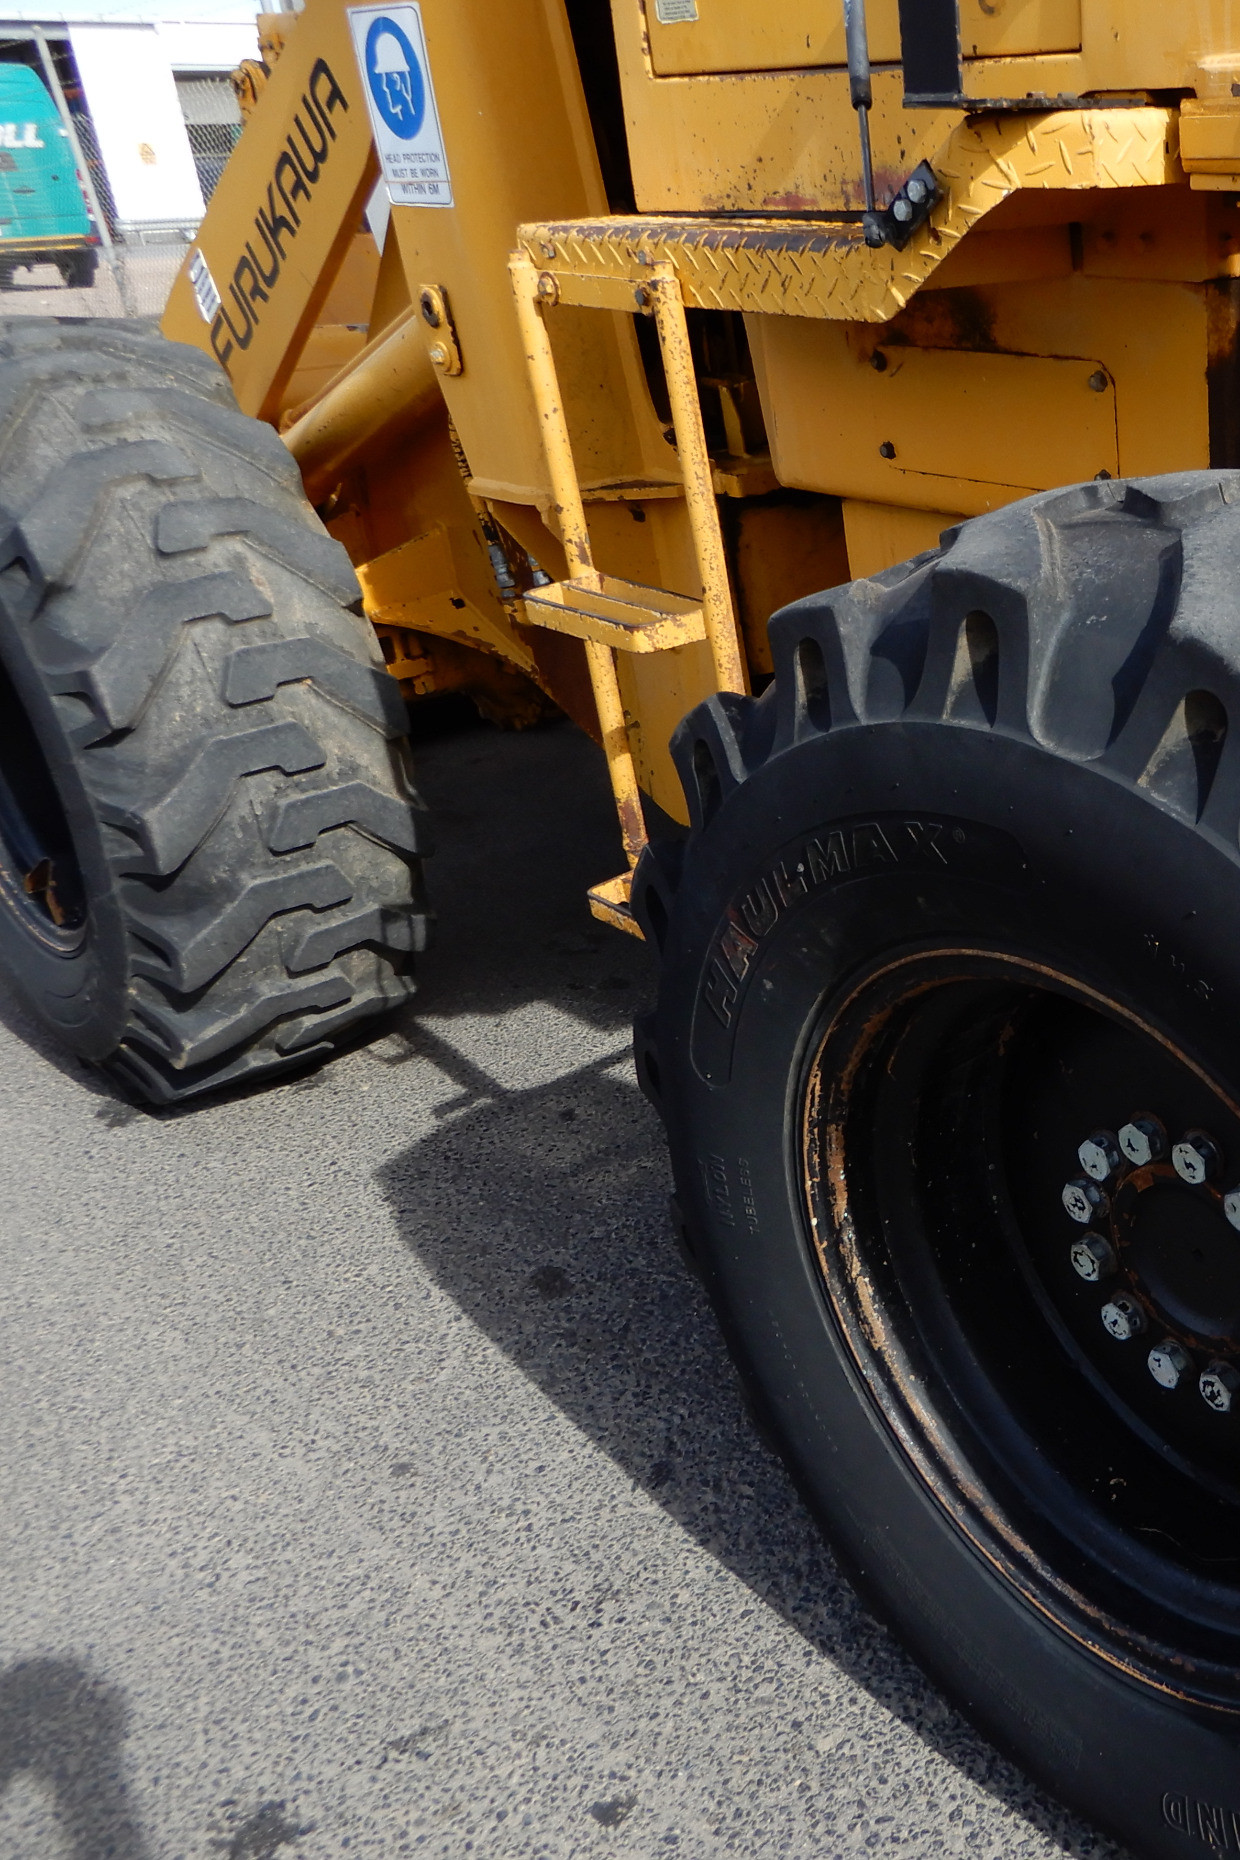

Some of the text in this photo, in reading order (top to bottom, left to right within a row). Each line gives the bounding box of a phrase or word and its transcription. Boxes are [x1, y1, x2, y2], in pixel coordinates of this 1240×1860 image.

[0, 123, 44, 148] LL
[385, 152, 440, 164] HEAD PROTECTION
[392, 168, 439, 178] MUST BE WORN
[401, 183, 441, 195] WITHIN 6M
[210, 57, 349, 382] FURUKAWA
